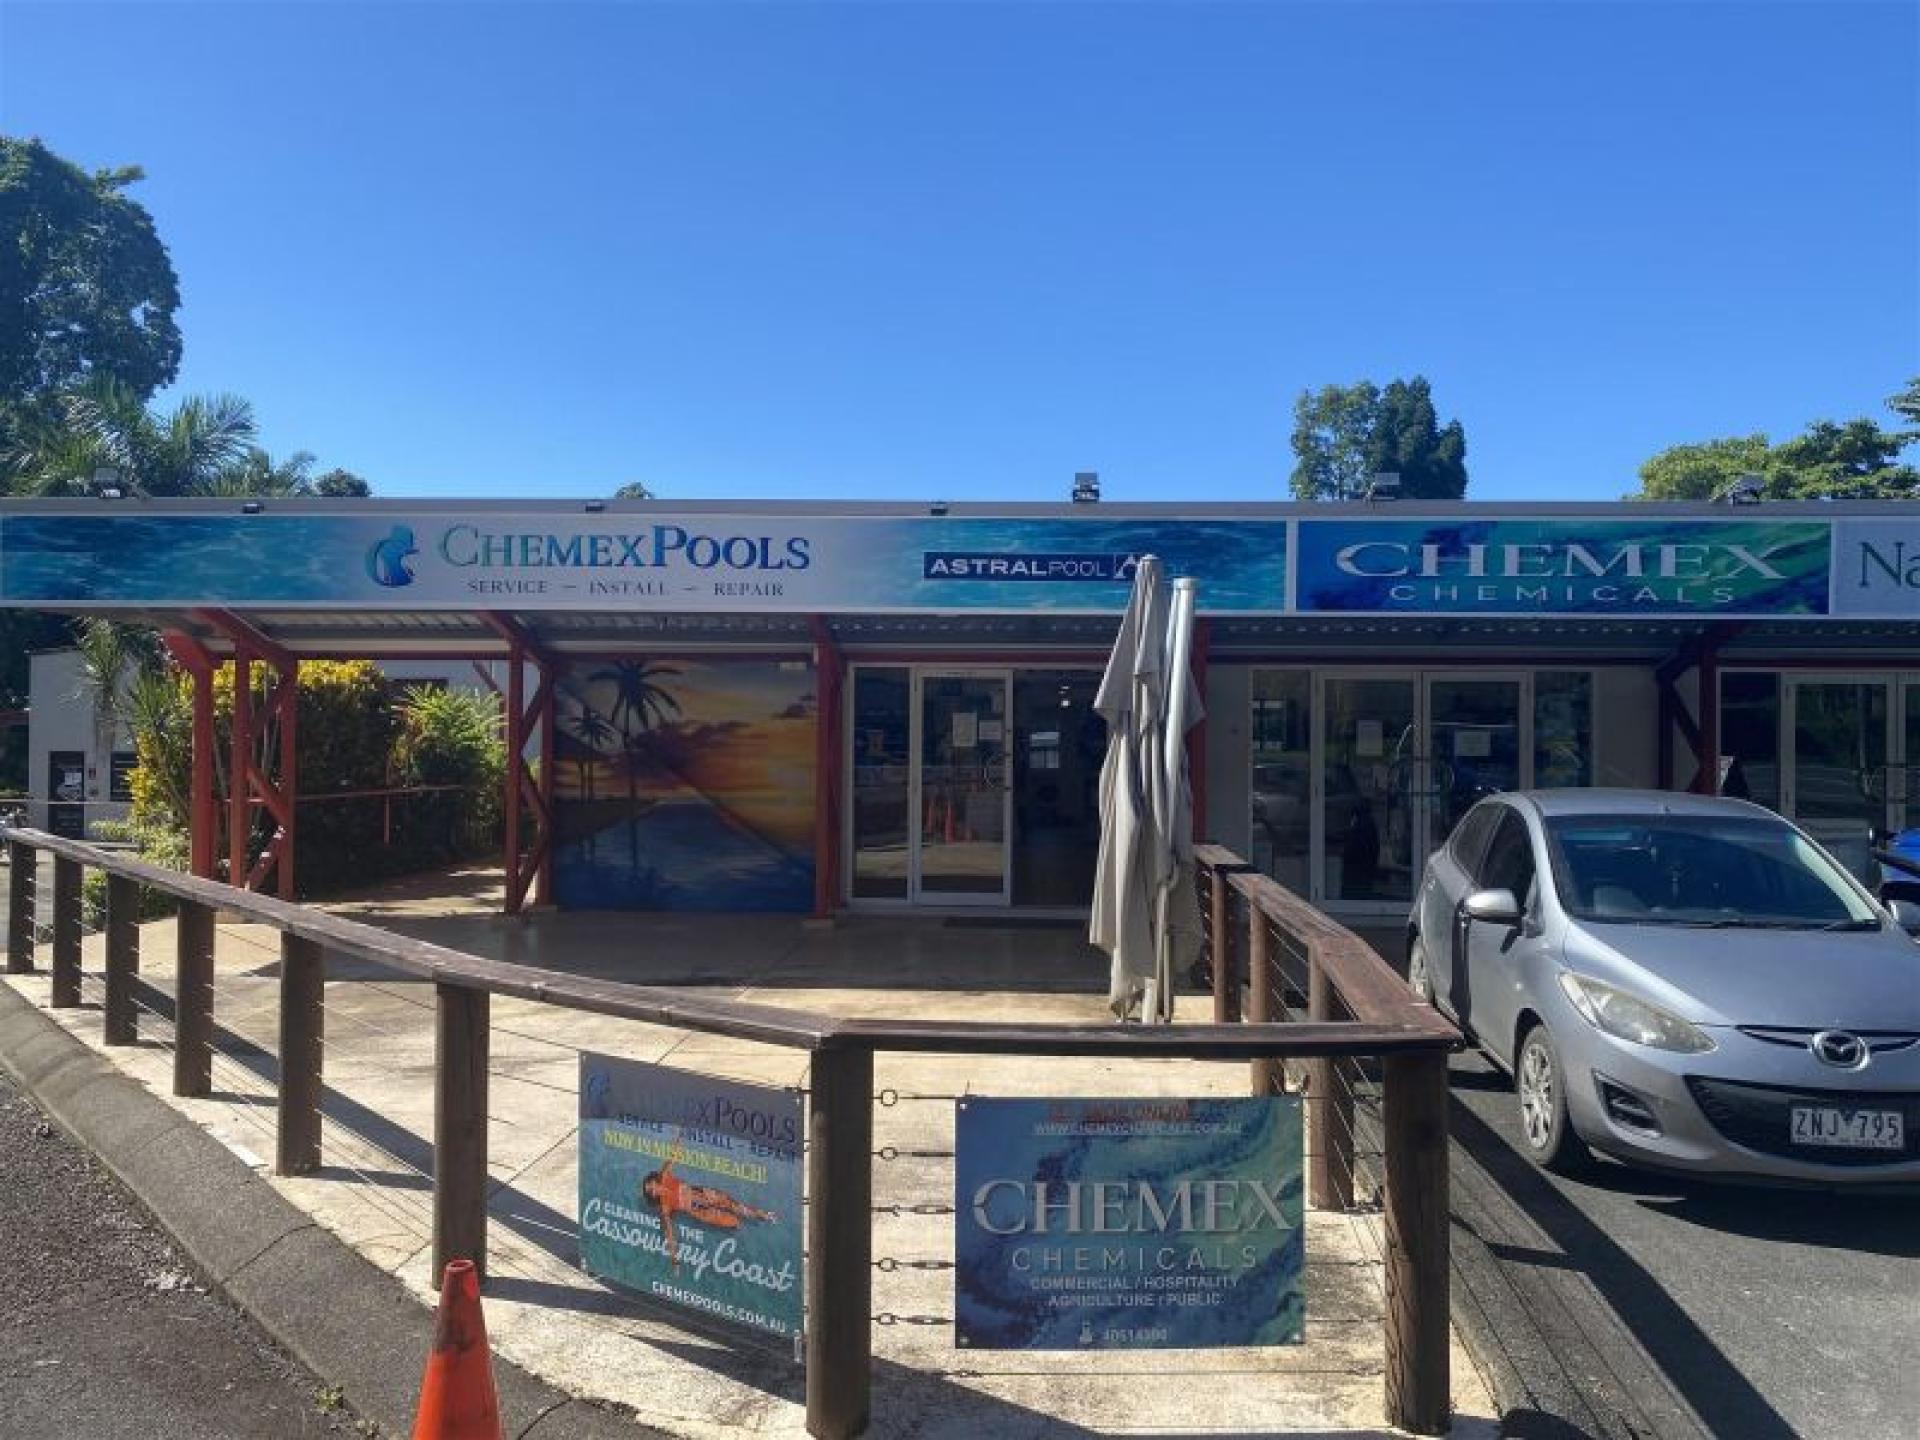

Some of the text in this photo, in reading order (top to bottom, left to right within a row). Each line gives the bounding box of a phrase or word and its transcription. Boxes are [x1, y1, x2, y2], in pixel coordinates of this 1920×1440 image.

[930, 558, 1107, 577] ASTRALPOOL
[1335, 542, 1787, 580] CHEMEX
[468, 579, 548, 594] SERVICE
[589, 580, 667, 596] INSTALL
[714, 582, 784, 597] REPAIR
[1389, 584, 1735, 603] CHEMICALS
[1857, 1113, 1898, 1139] 795
[604, 1129, 632, 1151] NOW
[604, 1201, 661, 1230] CLEANING
[972, 1178, 1294, 1235] CHEMEX
[680, 1225, 704, 1243] THE
[714, 1238, 796, 1292] Coast
[1012, 1247, 1258, 1271] CHEMICALS
[1031, 1276, 1130, 1291] COMMERCIAL
[1145, 1276, 1239, 1291] HOSPITALITY
[1048, 1293, 1155, 1307] AGRICULTURE
[1166, 1293, 1222, 1307] PUBLIC
